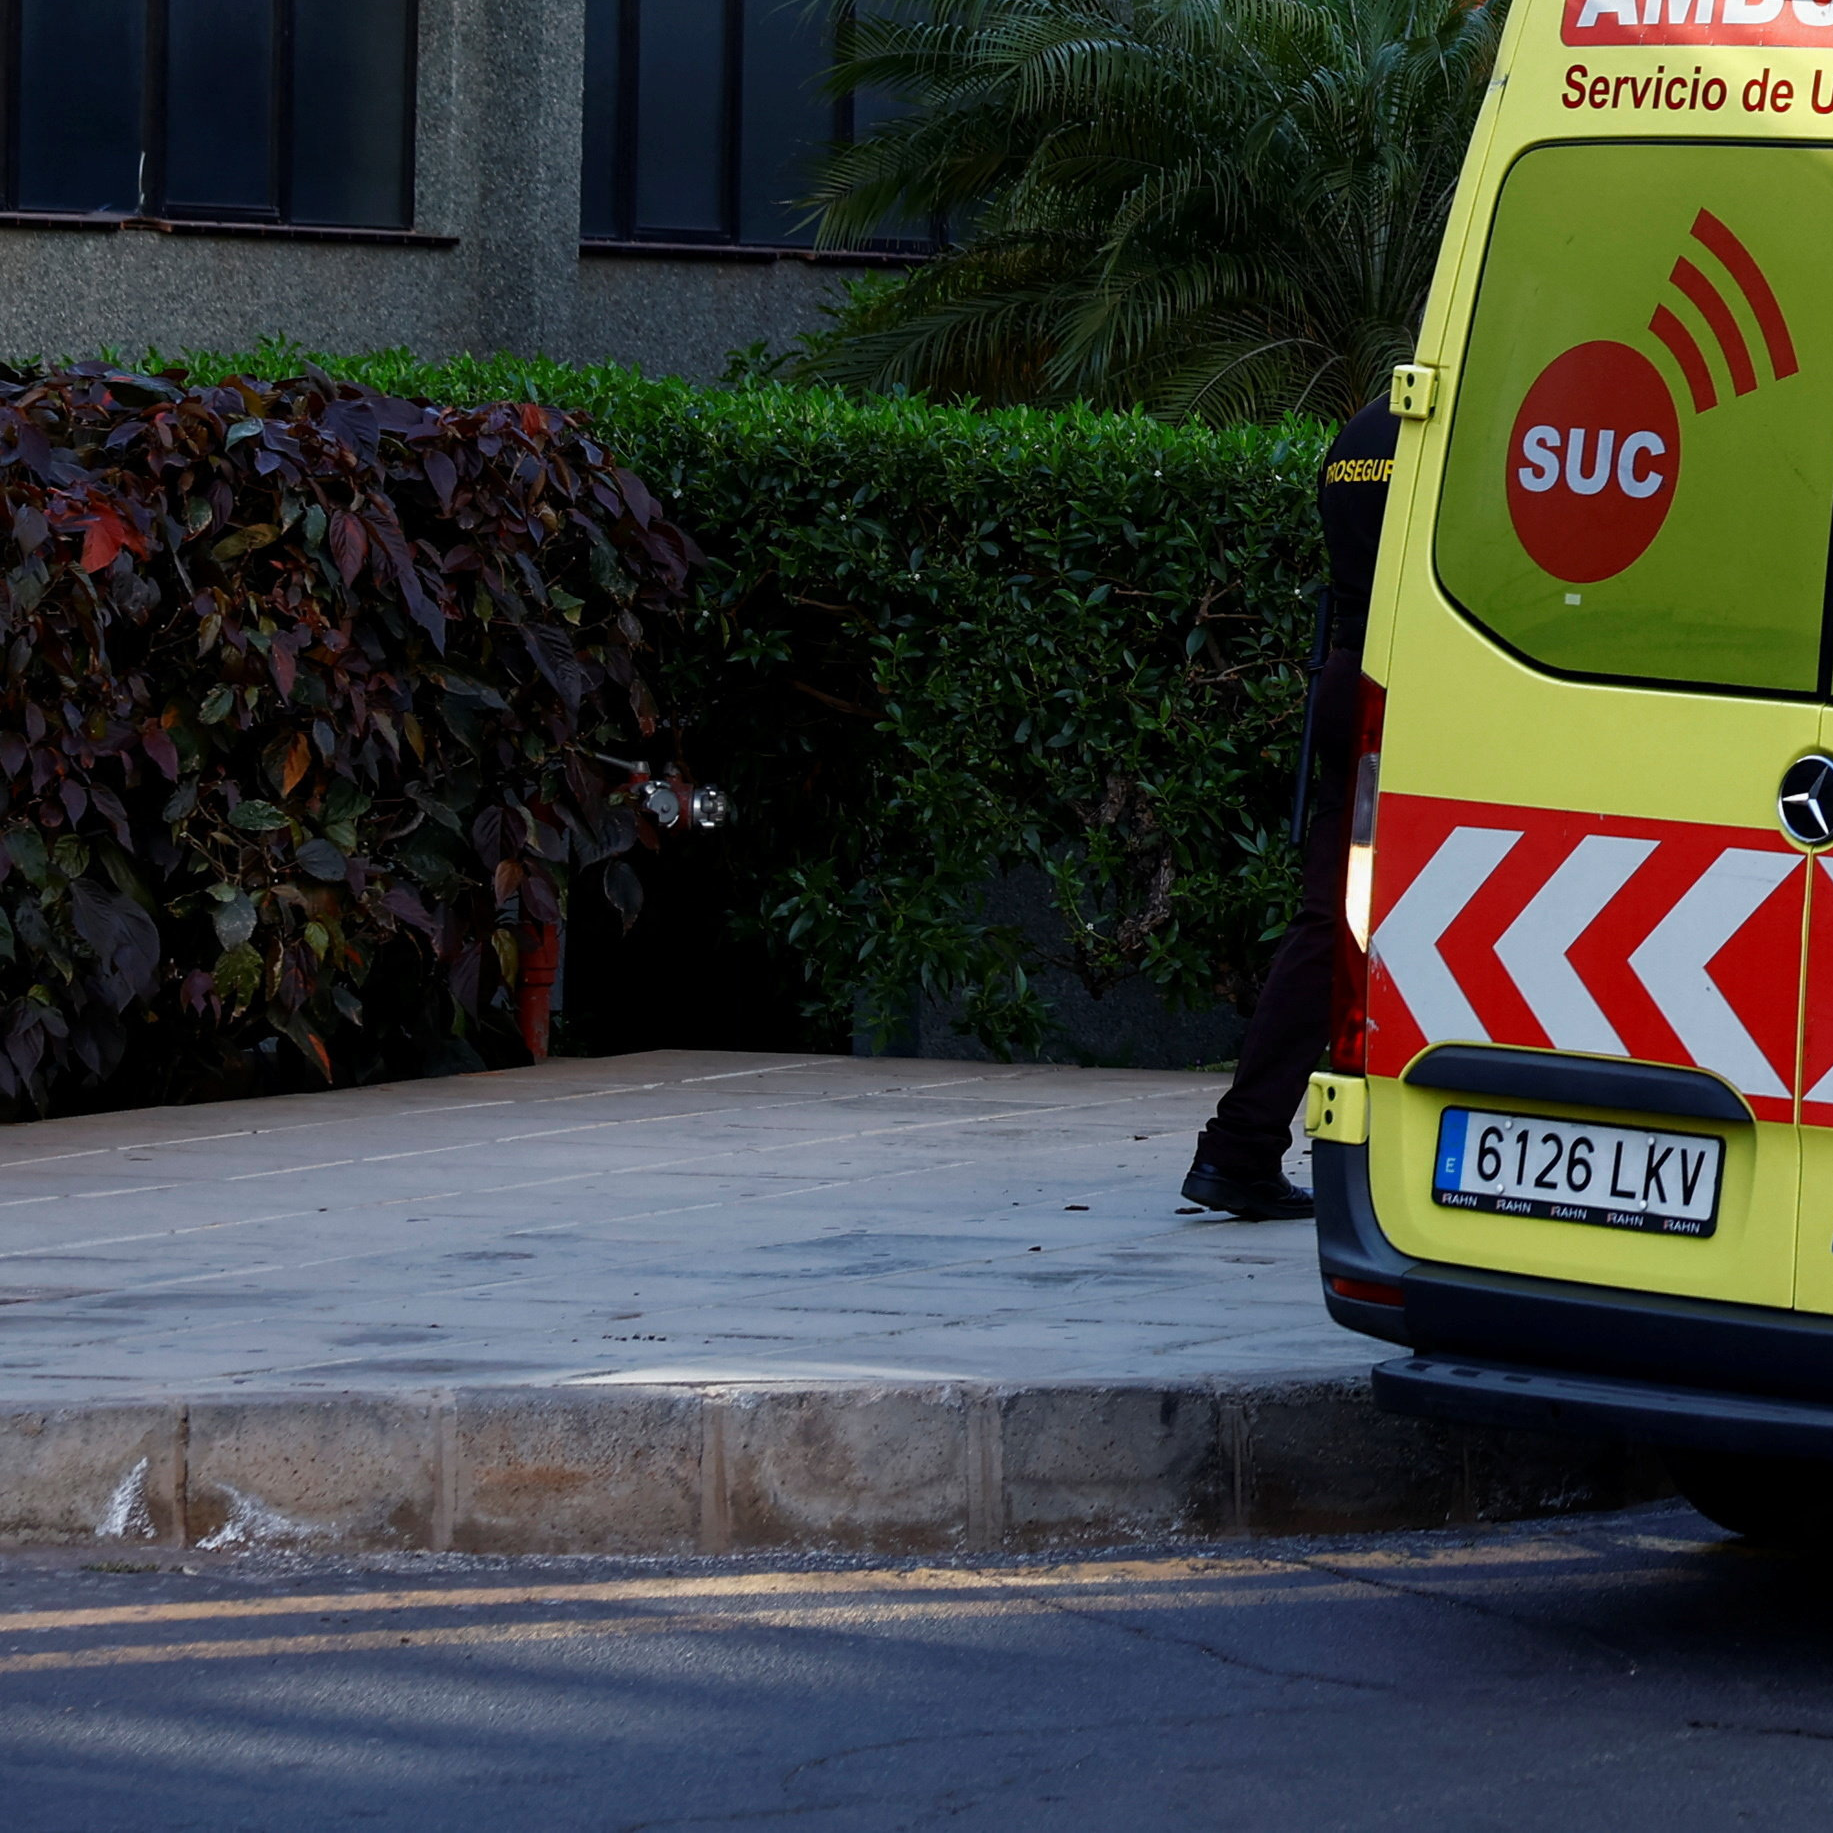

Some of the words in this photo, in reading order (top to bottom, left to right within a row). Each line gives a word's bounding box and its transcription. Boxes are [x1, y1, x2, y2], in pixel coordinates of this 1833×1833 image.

[1561, 64, 1728, 112] Servicio
[1741, 68, 1795, 114] de
[1517, 425, 1666, 500] SUC
[1445, 1157, 1456, 1174] E
[1476, 1125, 1595, 1193] 6126
[1609, 1140, 1706, 1208] LKV
[1442, 1192, 1478, 1208] RAHN
[1496, 1198, 1532, 1214] RAHN
[1550, 1205, 1587, 1221] RAHN
[1606, 1212, 1644, 1227] RAHN
[1663, 1219, 1700, 1234] RAHN
